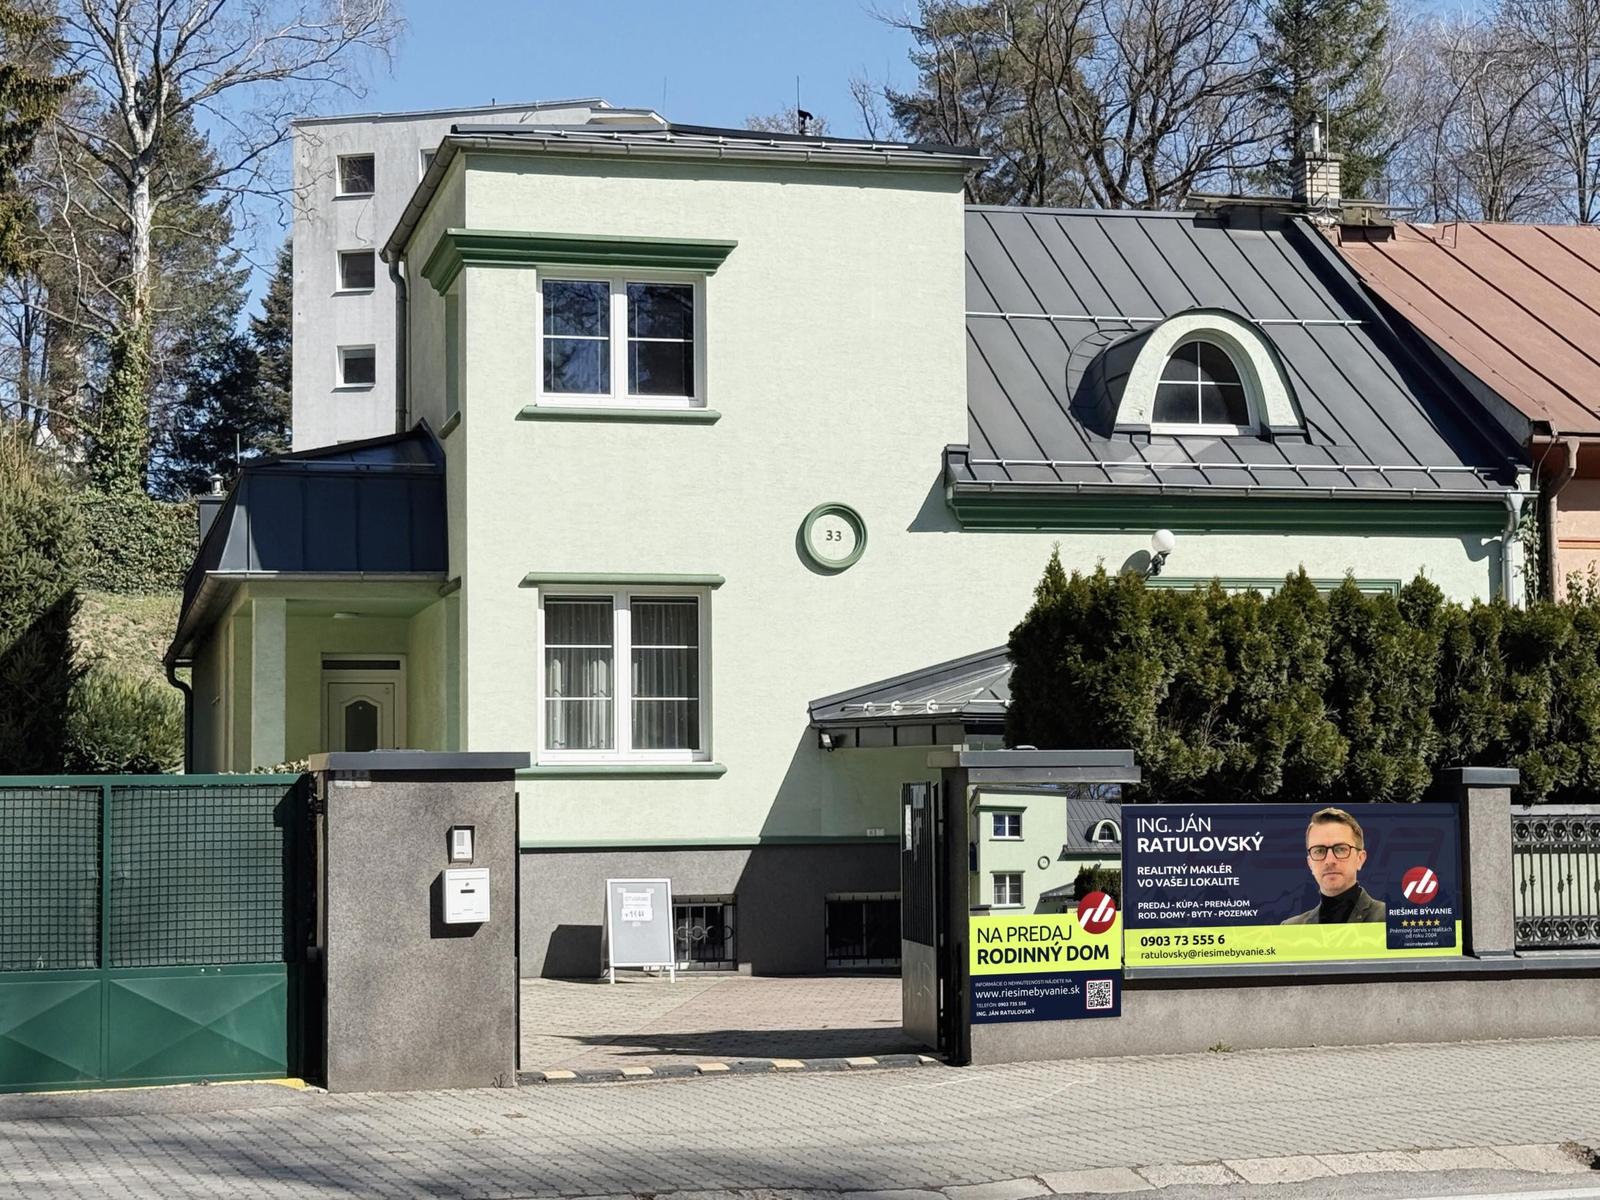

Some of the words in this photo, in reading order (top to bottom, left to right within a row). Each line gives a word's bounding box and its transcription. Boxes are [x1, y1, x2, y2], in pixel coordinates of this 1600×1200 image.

[826, 530, 842, 542] 33
[1137, 818, 1172, 833] ING.
[1176, 813, 1211, 833] JÁN
[1137, 832, 1264, 853] RATULOVSKÝ
[1137, 864, 1189, 875] REALITNÝ
[1190, 863, 1232, 874] MAKLÉR
[1137, 879, 1154, 888] VO
[1155, 876, 1189, 887] VAŠEJ
[1190, 877, 1240, 887] LOKALITE
[1205, 899, 1250, 908] PRENÁJOM
[1160, 911, 1185, 919] DOMY
[1219, 910, 1258, 918] POZEMKY
[1389, 907, 1418, 916] RIEŠIME
[1419, 906, 1452, 914] BÝVANIE
[977, 927, 1003, 944] NA
[1007, 925, 1073, 942] PREDAJ
[1141, 937, 1171, 947] 0903
[1174, 936, 1189, 946] 73
[1193, 936, 1215, 945] 555
[1218, 935, 1225, 945] 6
[977, 942, 1063, 965] RODINNÝ
[1067, 945, 1109, 961] DOM
[1141, 947, 1276, 960] ratulovsky@riesimebyvanie.sk
[975, 985, 1081, 999] www.riesimebyvanie.sk
